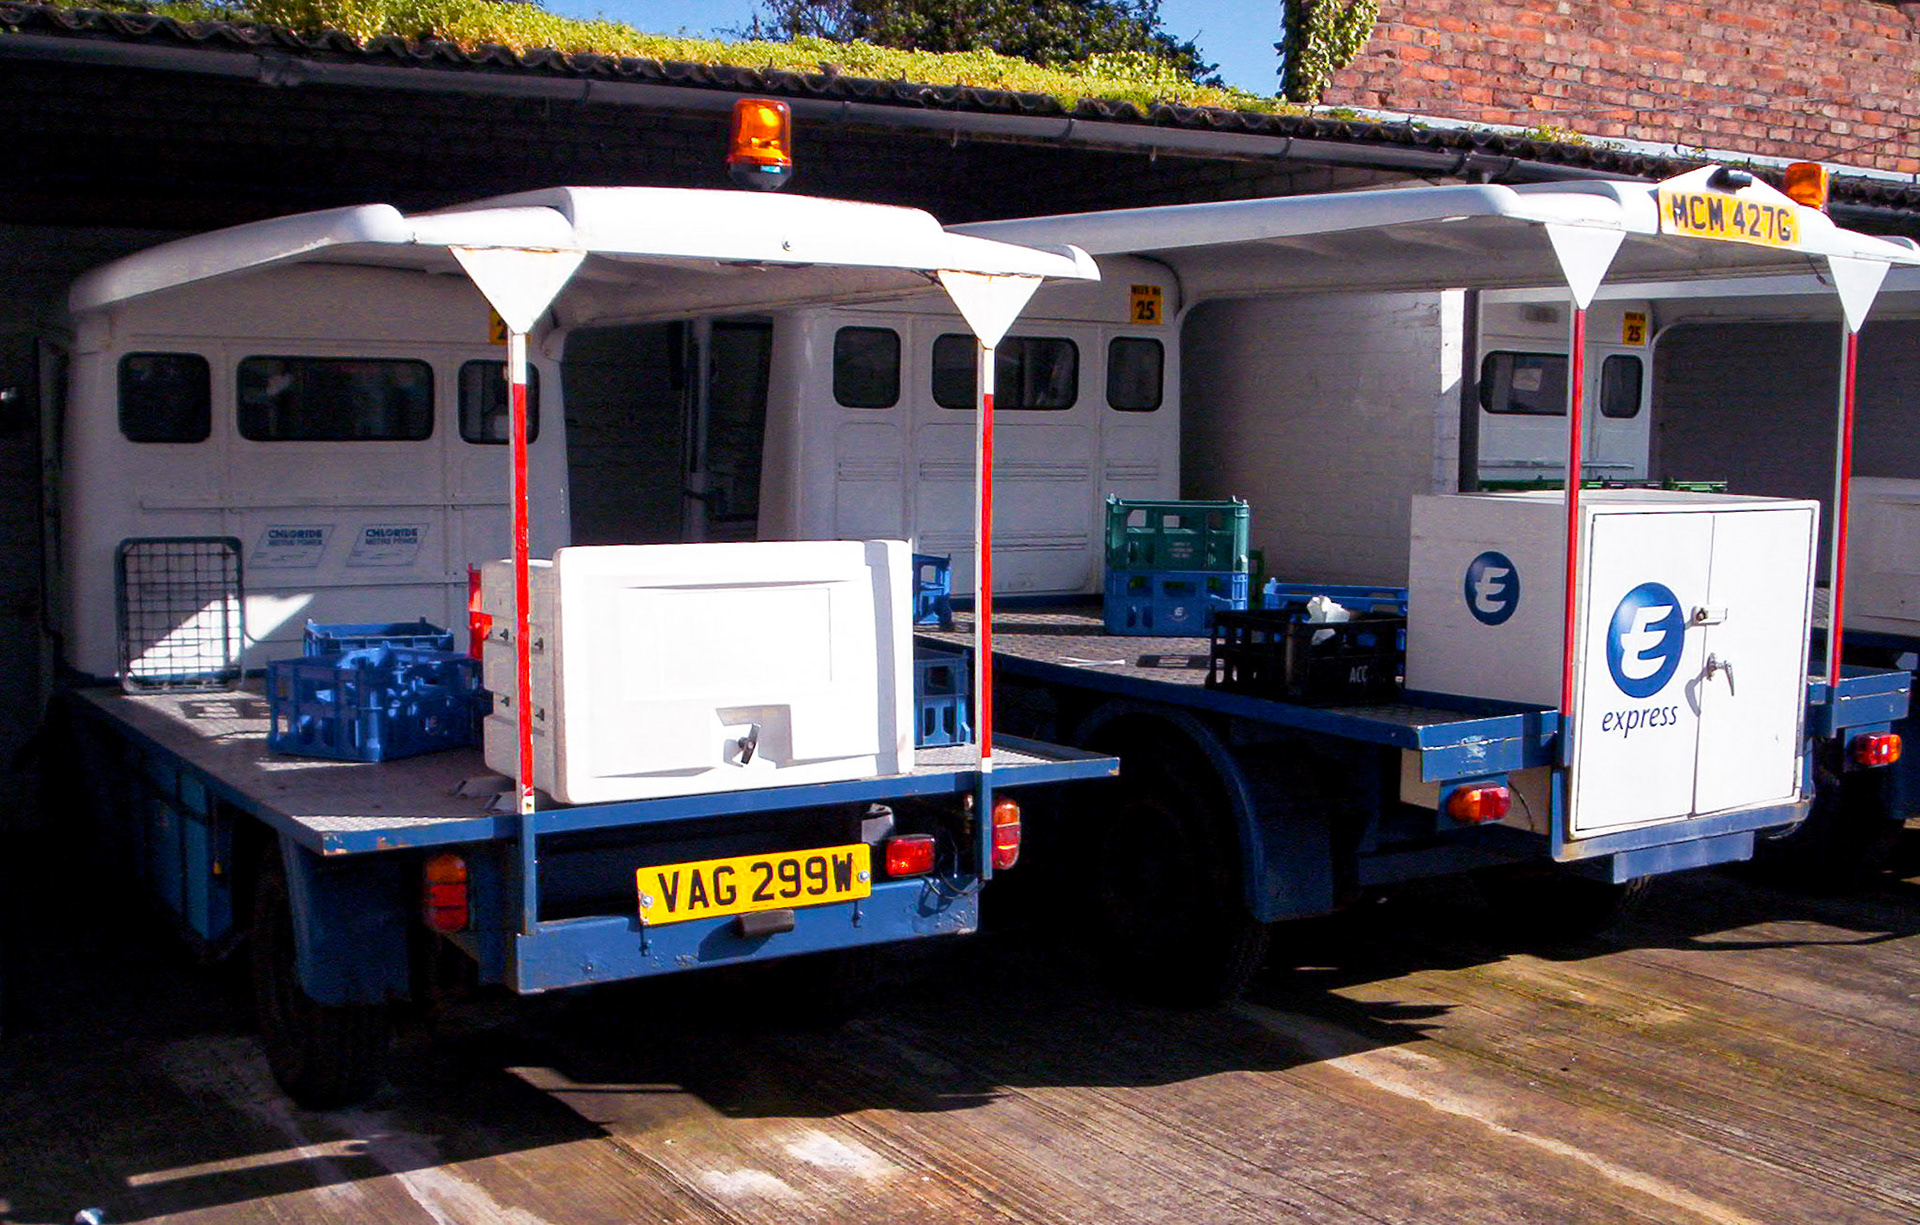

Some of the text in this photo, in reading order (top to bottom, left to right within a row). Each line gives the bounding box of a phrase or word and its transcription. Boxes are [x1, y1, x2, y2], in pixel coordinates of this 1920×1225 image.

[1672, 195, 1791, 241] MCM 427G
[1136, 300, 1155, 320] 25
[1627, 325, 1642, 341] 25
[268, 529, 323, 539] CHLORIDE
[365, 528, 418, 537] CHLORIDE
[1602, 705, 1678, 738] express
[657, 852, 853, 913] VAG 299W
